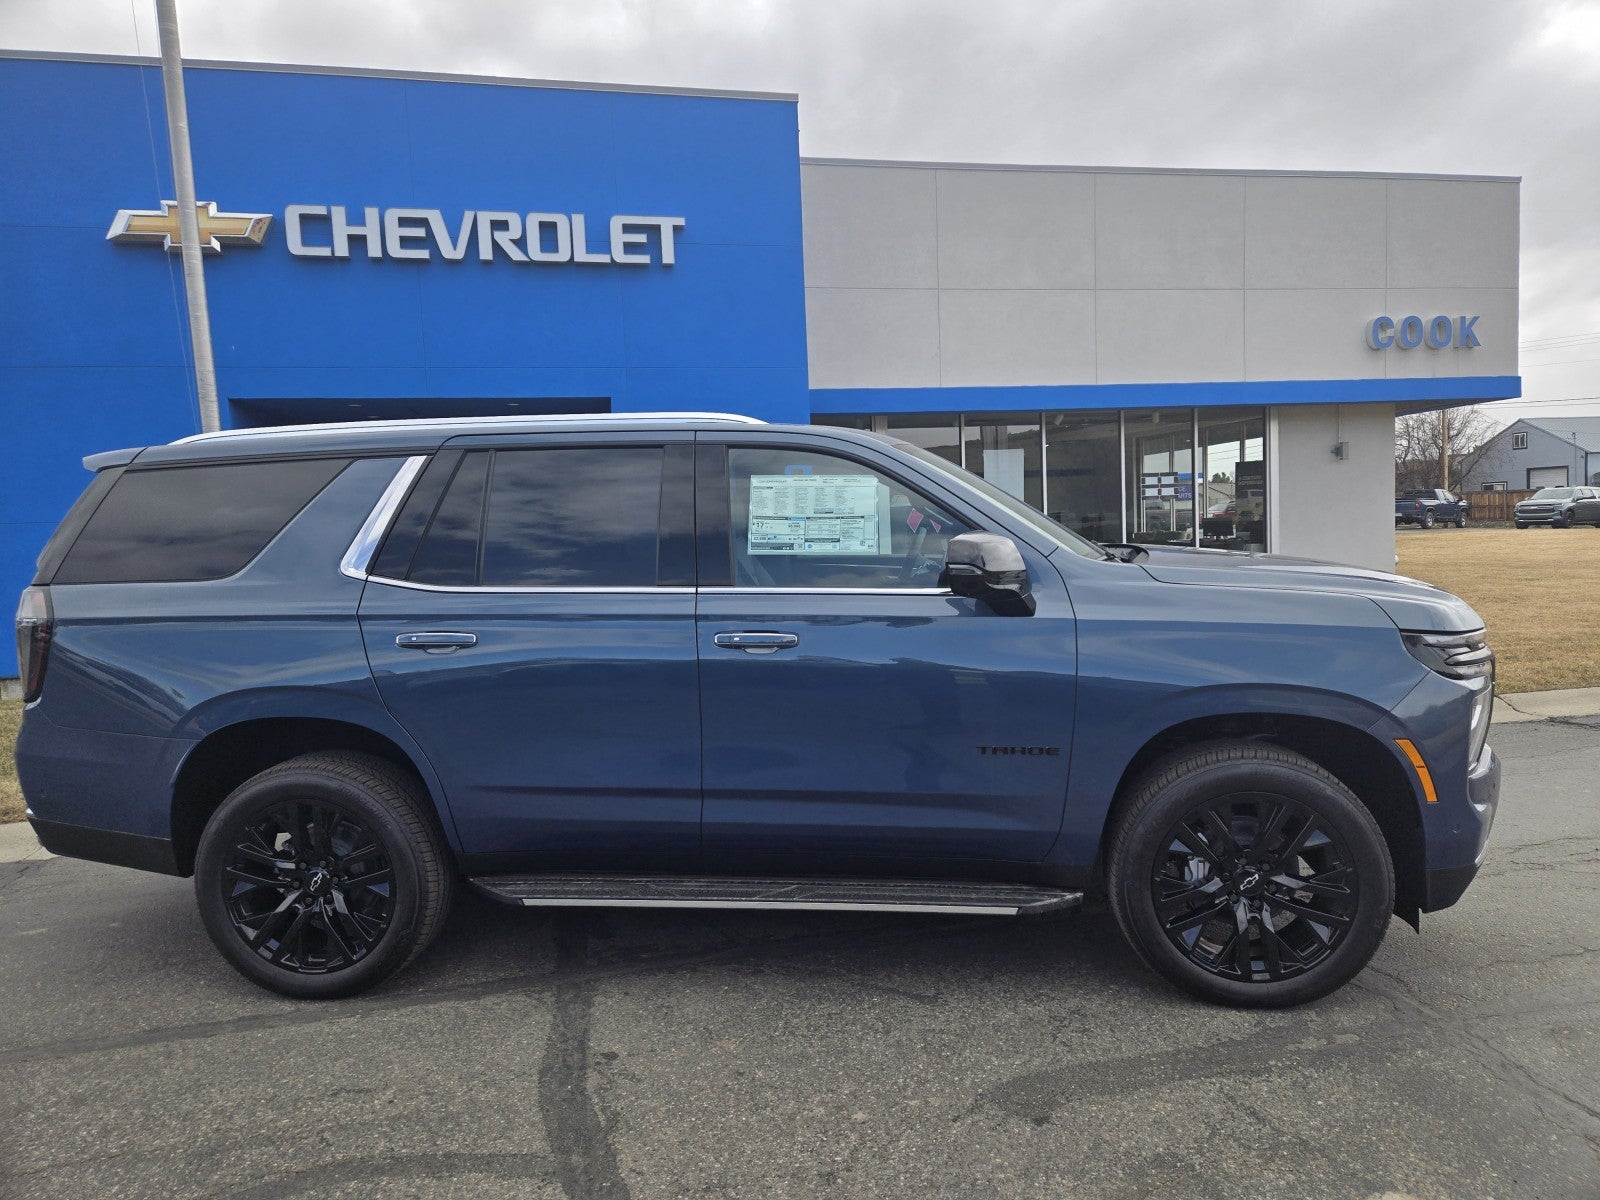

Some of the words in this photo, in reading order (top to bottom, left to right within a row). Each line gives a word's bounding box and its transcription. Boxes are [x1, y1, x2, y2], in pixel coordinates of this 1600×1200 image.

[284, 203, 686, 267] CHEVROLET
[1367, 315, 1481, 350] COOK
[976, 746, 1060, 756] TAHOE
